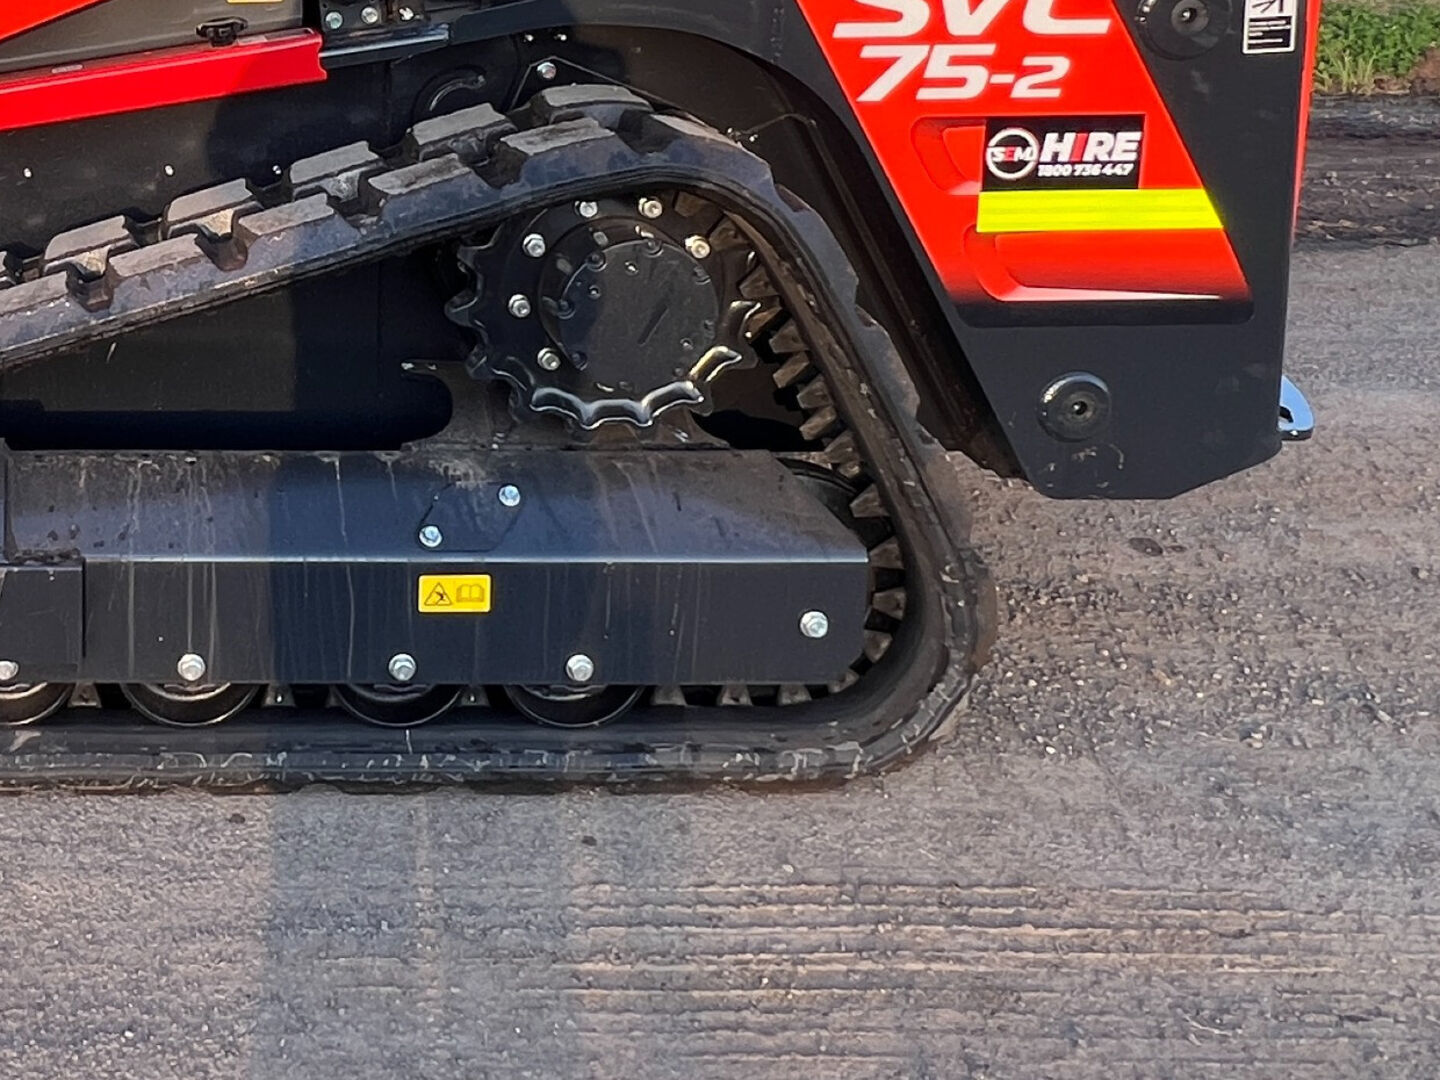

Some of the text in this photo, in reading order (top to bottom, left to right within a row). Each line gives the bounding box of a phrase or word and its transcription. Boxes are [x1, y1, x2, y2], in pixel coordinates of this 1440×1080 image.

[856, 43, 1071, 102] 75-2
[991, 146, 1034, 163] SEM
[1039, 131, 1143, 162] HIRE
[1038, 163, 1073, 178] 1800
[1101, 163, 1135, 176] 447
